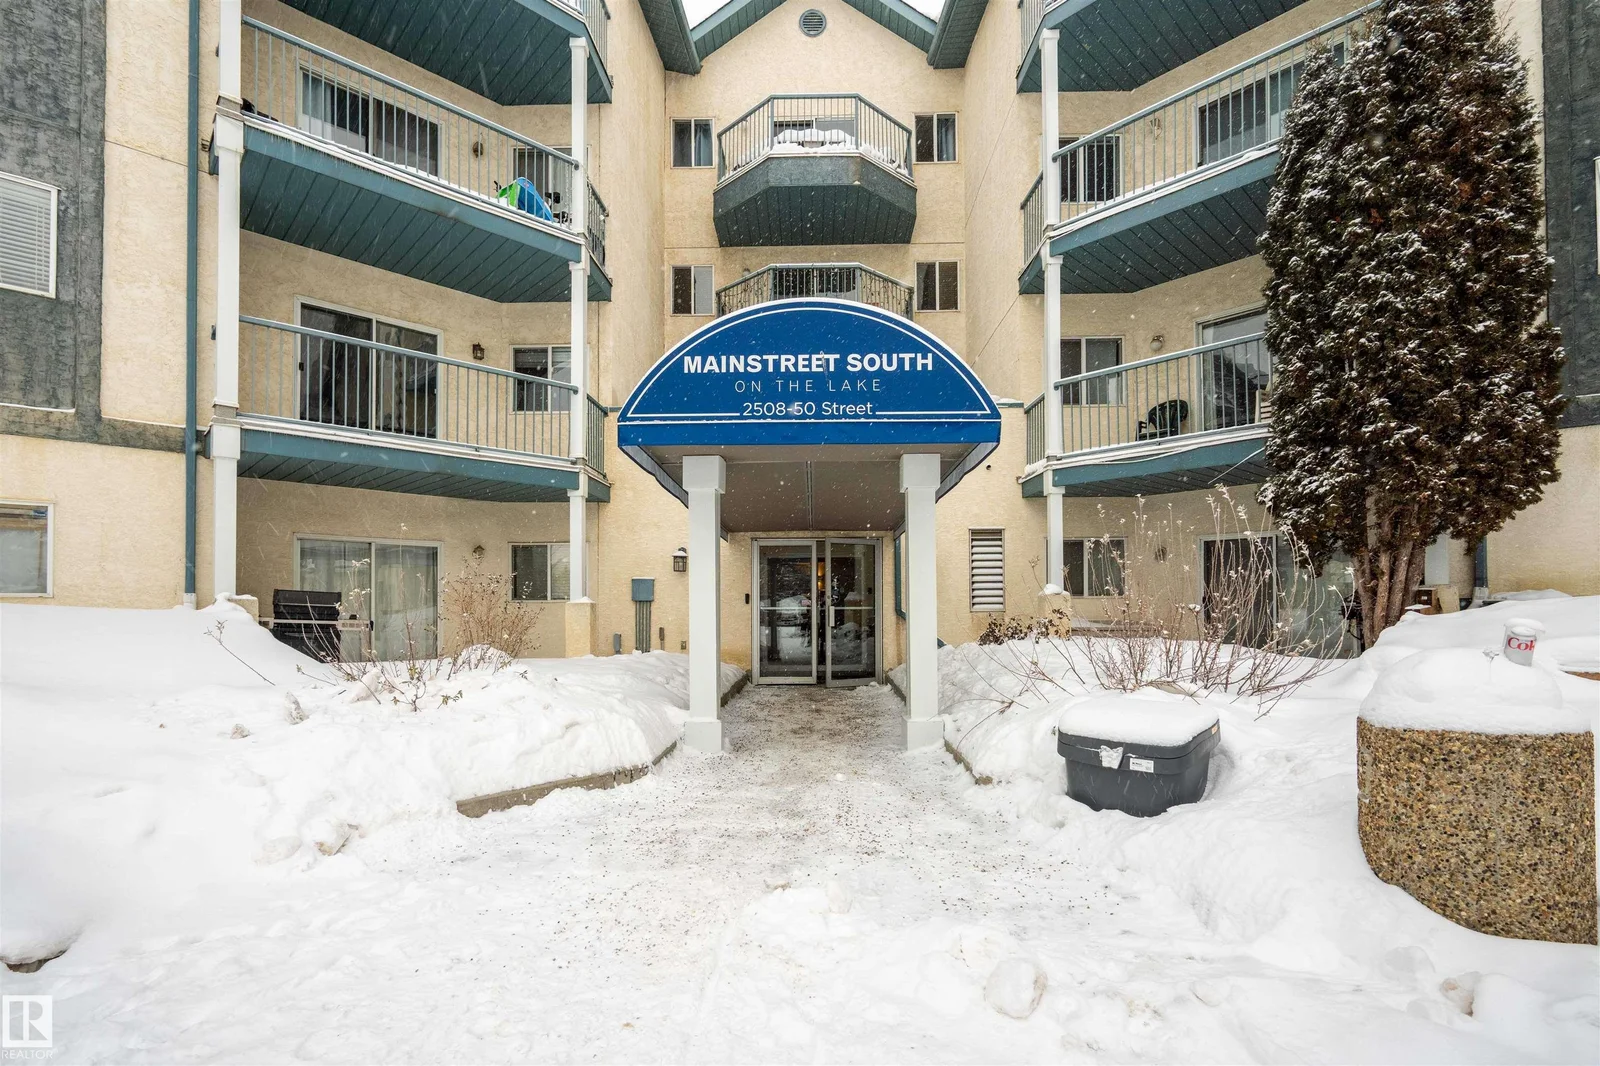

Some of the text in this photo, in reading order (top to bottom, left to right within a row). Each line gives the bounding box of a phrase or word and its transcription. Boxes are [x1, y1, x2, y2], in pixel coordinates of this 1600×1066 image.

[684, 352, 933, 373] MAINSTREET SOUTH
[734, 379, 881, 393] ON THE LAKE
[742, 401, 873, 416] 2508-50 Street
